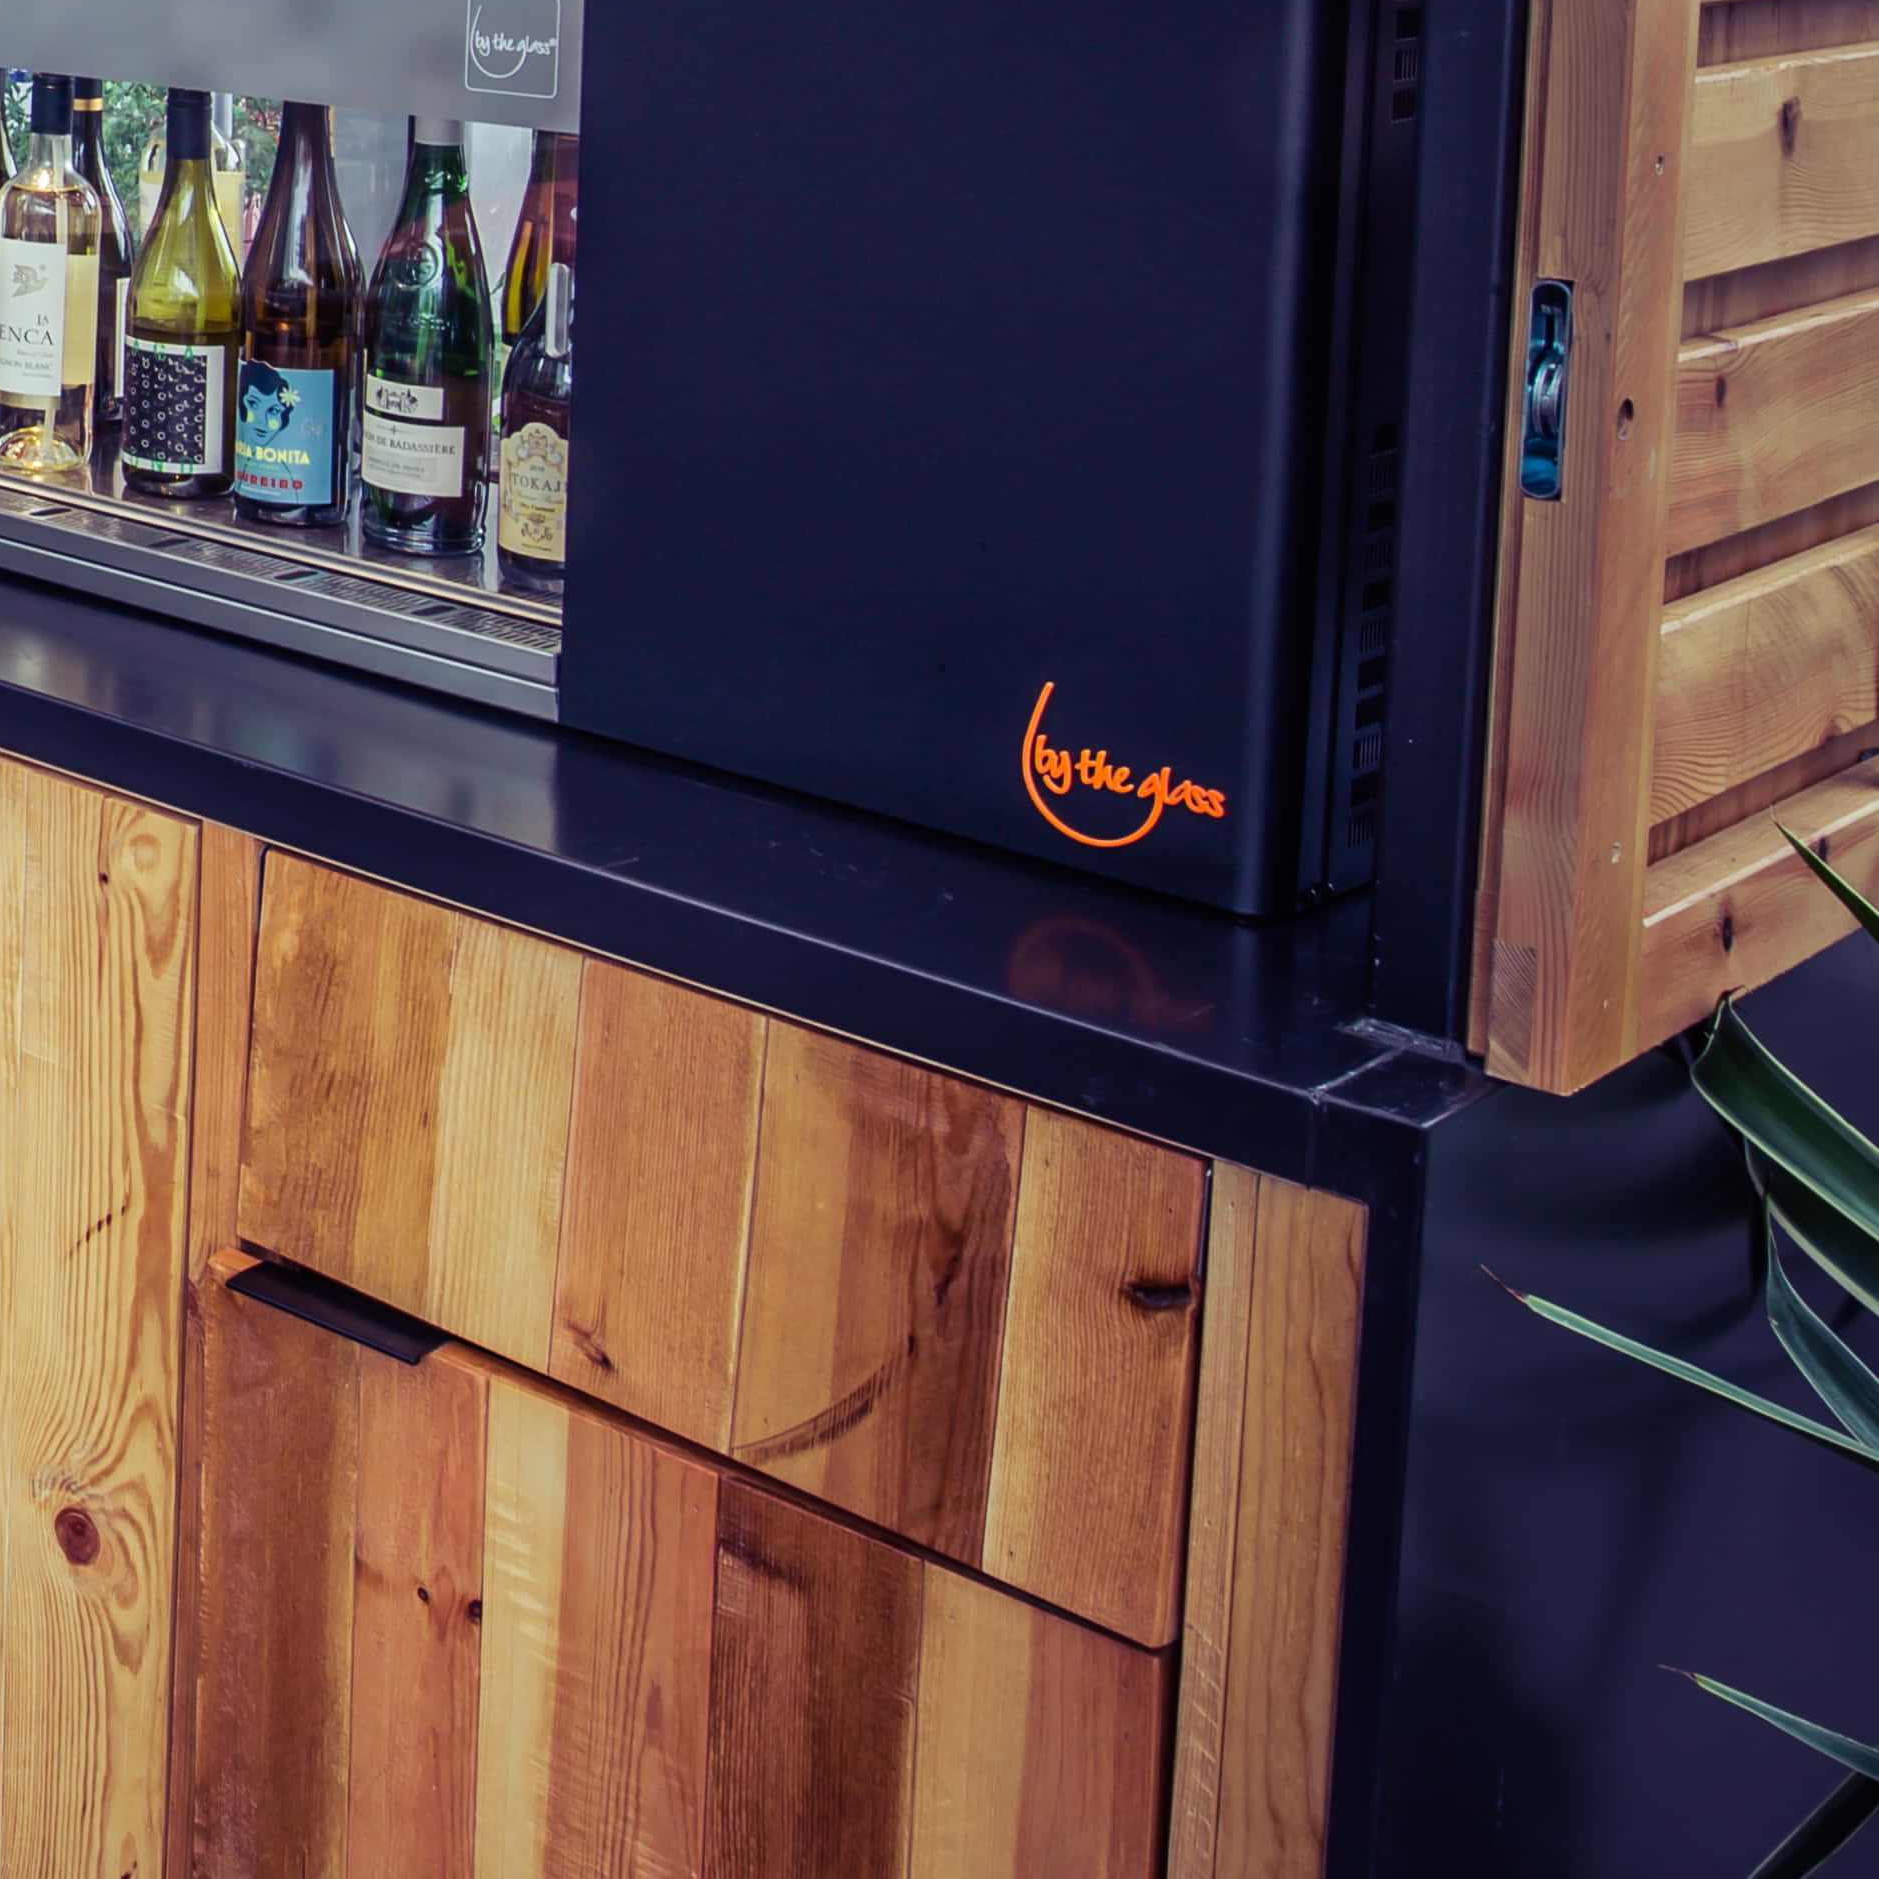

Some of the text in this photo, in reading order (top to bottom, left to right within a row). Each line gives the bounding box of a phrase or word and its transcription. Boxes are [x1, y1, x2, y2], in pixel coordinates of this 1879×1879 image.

[475, 28, 491, 57] by
[493, 31, 516, 52] the
[255, 445, 311, 465] BONITA
[512, 472, 561, 493] TOKAJ
[1035, 734, 1226, 819] by the glass
